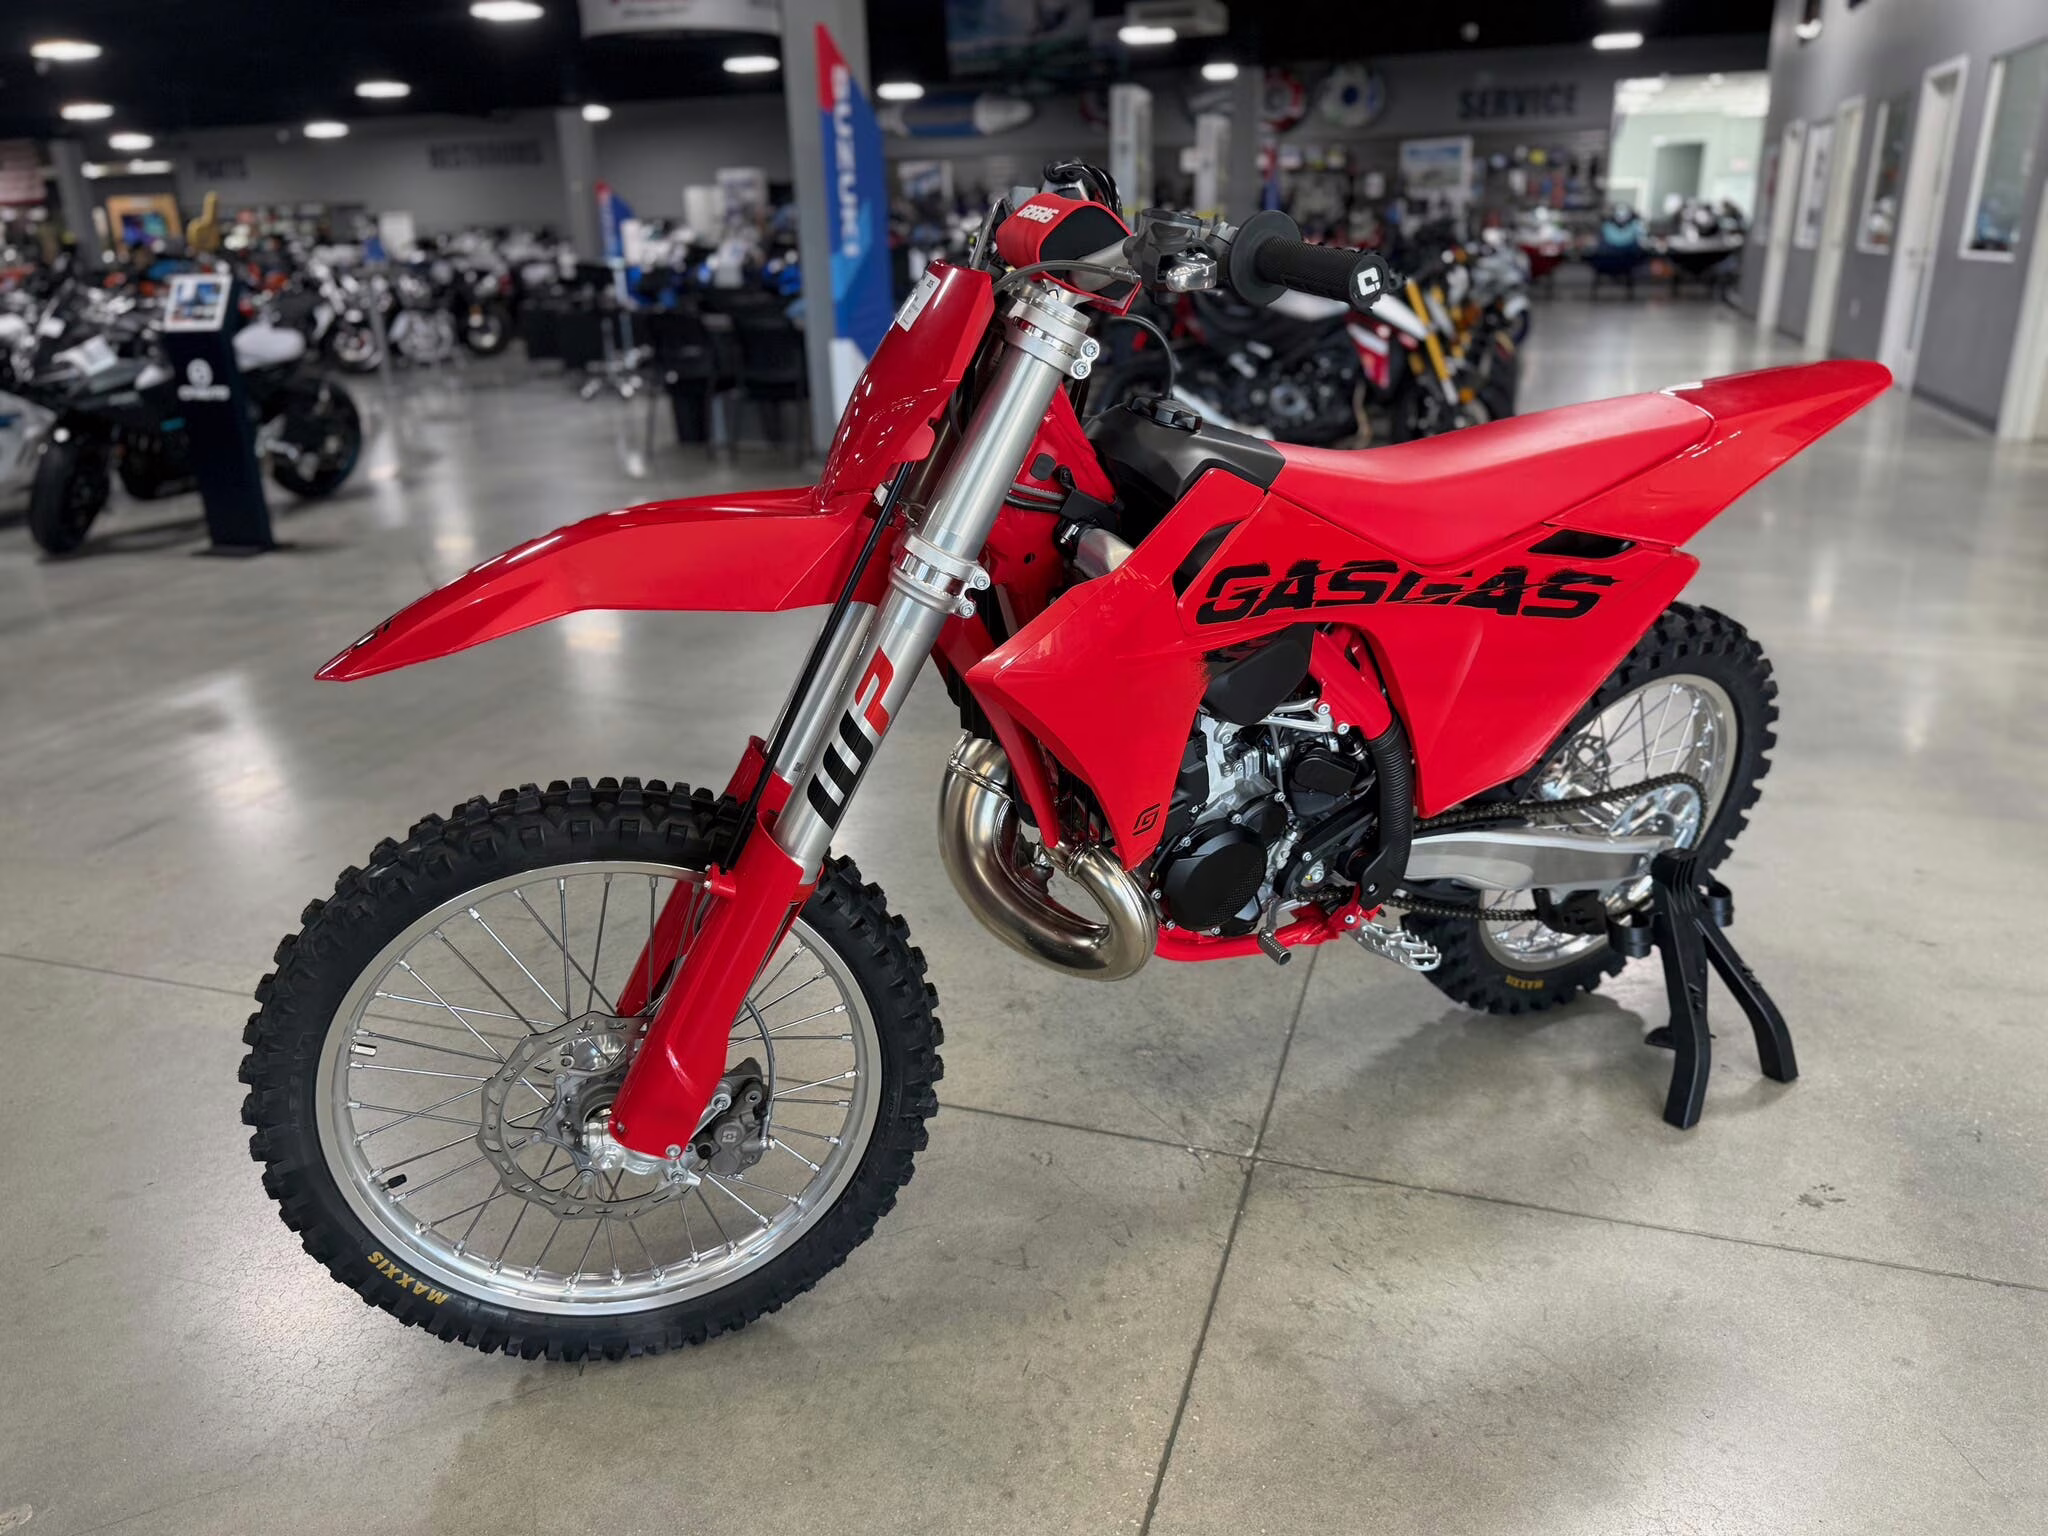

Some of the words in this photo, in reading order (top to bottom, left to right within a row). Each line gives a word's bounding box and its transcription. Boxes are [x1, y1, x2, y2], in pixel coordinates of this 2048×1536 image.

[1457, 81, 1577, 121] SERVICE
[830, 64, 861, 258] SUZUKI
[1195, 559, 1626, 624] GASGAS
[367, 1251, 450, 1305] MAXXIS
